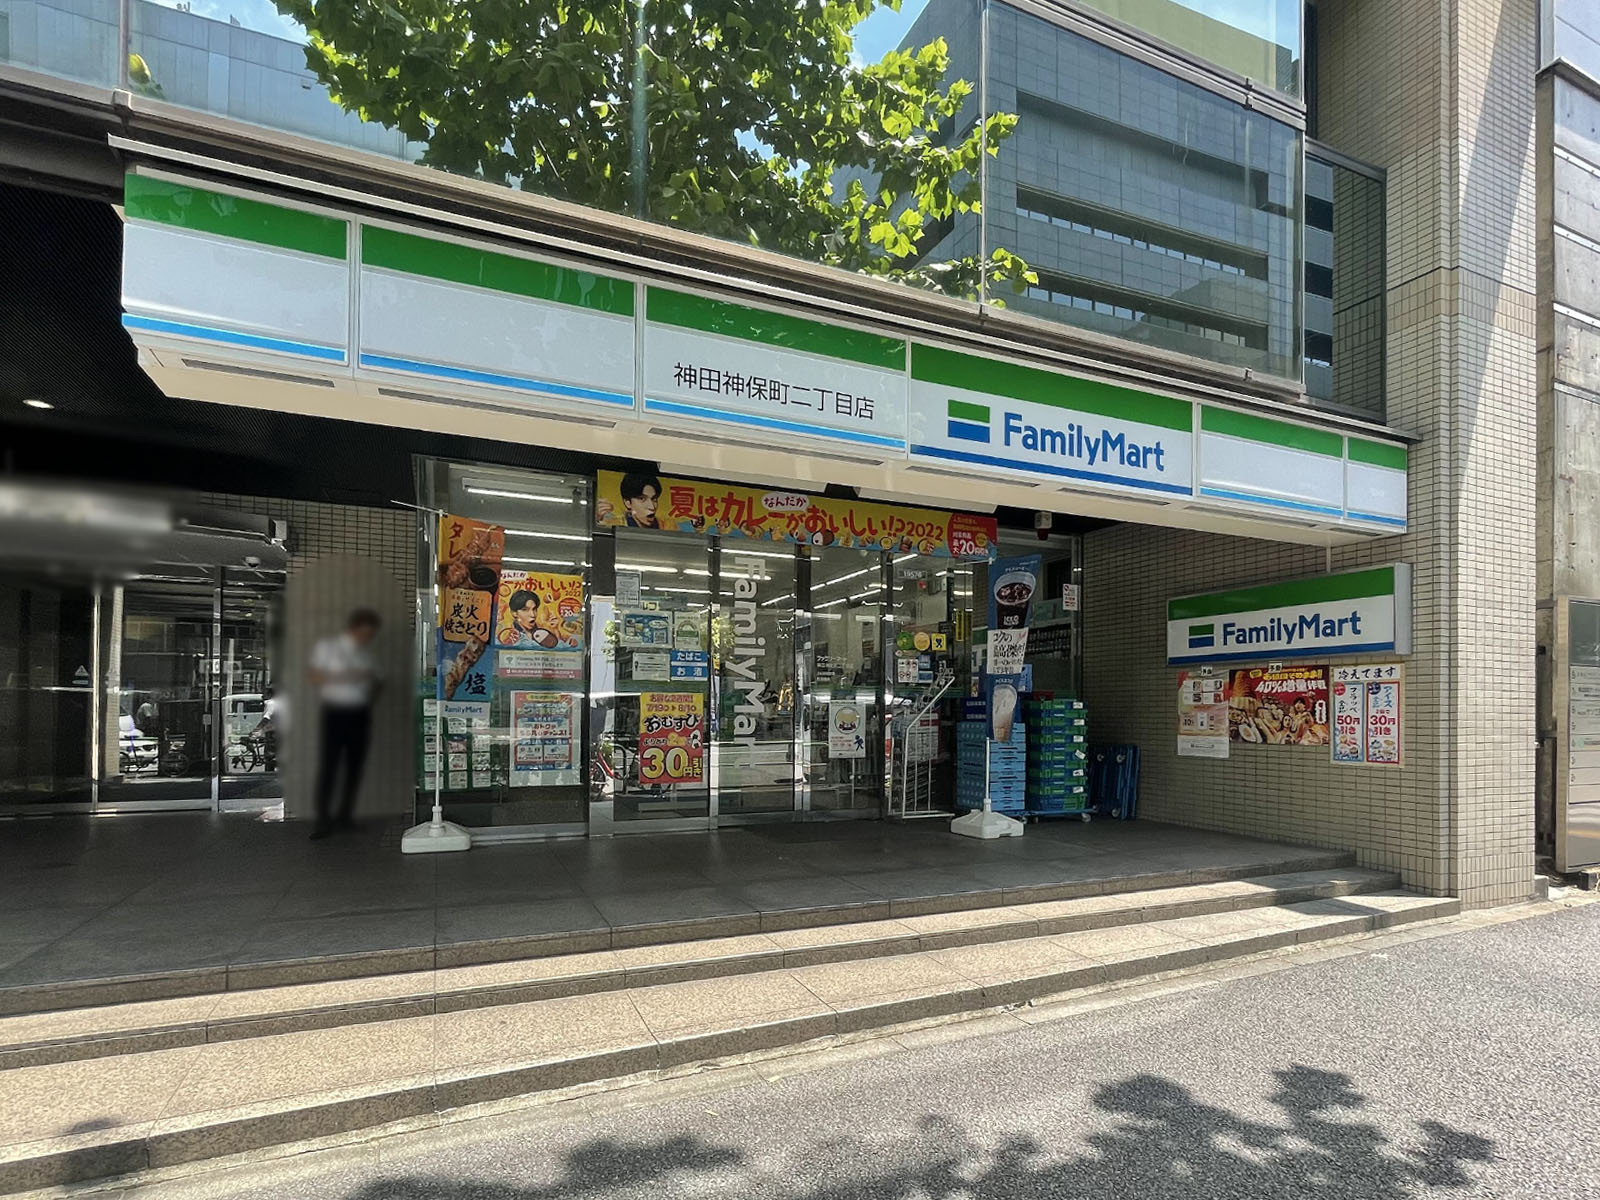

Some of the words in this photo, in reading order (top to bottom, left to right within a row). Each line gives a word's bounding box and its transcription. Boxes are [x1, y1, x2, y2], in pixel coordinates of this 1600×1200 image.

[674, 361, 876, 421] 神田神保町二丁目店
[1004, 412, 1165, 473] FamilyMart
[763, 496, 808, 509] なんだか
[449, 521, 466, 560] タレ
[450, 602, 479, 621] 炭火
[445, 618, 487, 636] 焼きとり
[1222, 610, 1362, 647] FamilyMart
[677, 652, 702, 661] たばこ
[464, 671, 487, 696] 塩
[1338, 666, 1396, 681] 冷えてます
[1383, 685, 1393, 708] アイス
